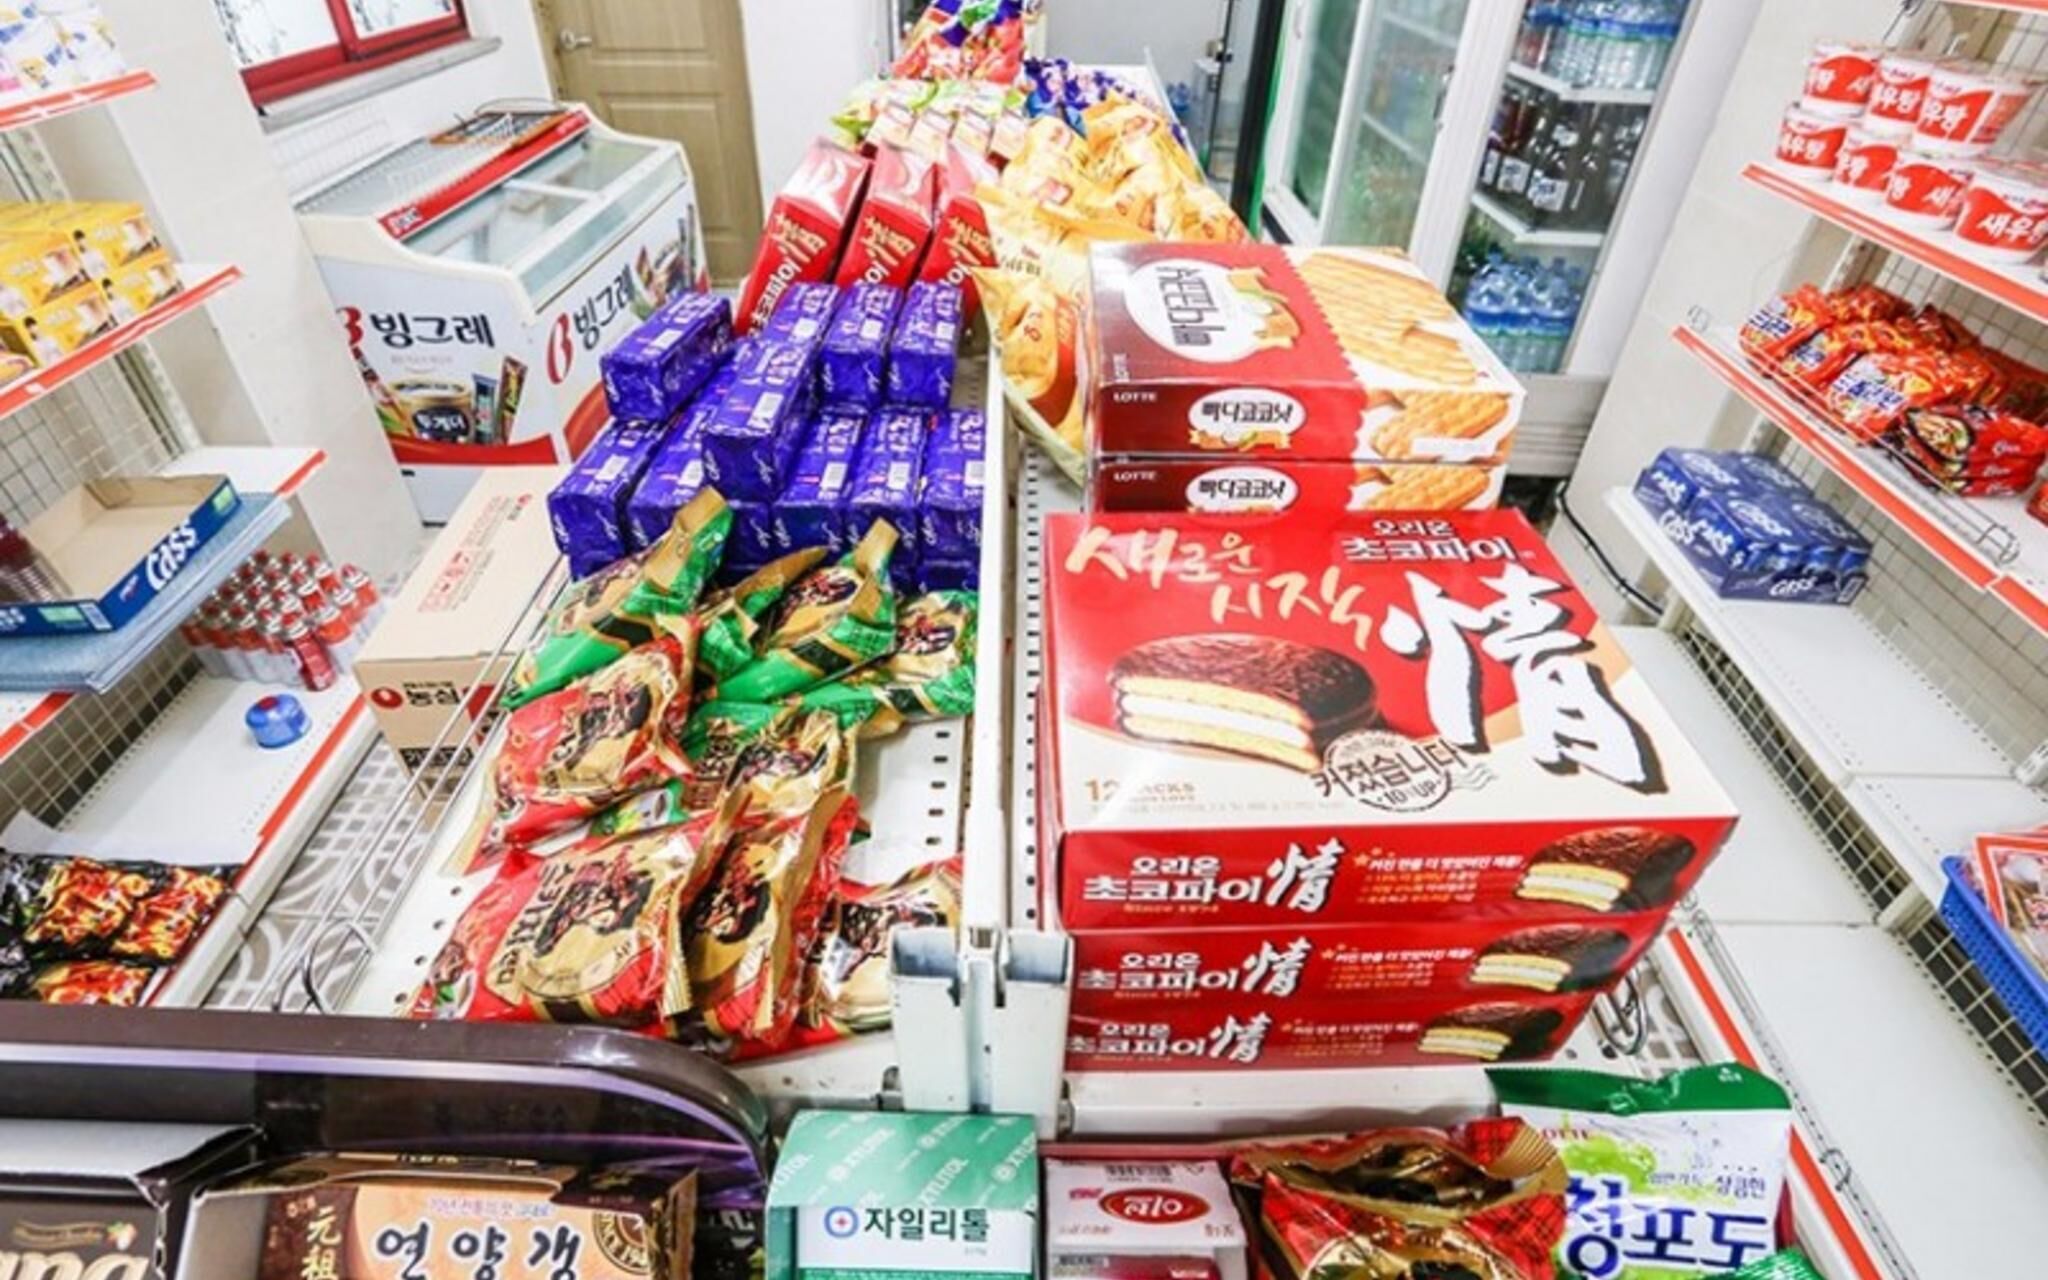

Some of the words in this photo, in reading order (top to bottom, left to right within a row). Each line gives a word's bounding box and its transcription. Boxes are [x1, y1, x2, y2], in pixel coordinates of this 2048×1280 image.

[572, 264, 635, 351] 빙그레
[369, 312, 496, 349] 빙그레
[1112, 391, 1158, 403] LOTTE
[1113, 471, 1158, 482] LOTTE
[1371, 519, 1454, 537] 오리온
[145, 518, 198, 592] Cass
[1064, 526, 1263, 590] 새로운
[1341, 536, 1517, 562] 초코파이
[1130, 855, 1222, 876] 오리온
[1264, 836, 1346, 914] 情
[1083, 874, 1263, 904] 초코파이
[1119, 950, 1201, 970] 오리온
[1077, 968, 1240, 993] 초코파이
[1099, 1021, 1171, 1039] 오리온
[1069, 1034, 1206, 1057] 초코파이
[863, 1206, 990, 1243] 자일리톨
[1565, 1175, 1768, 1279] 청포도
